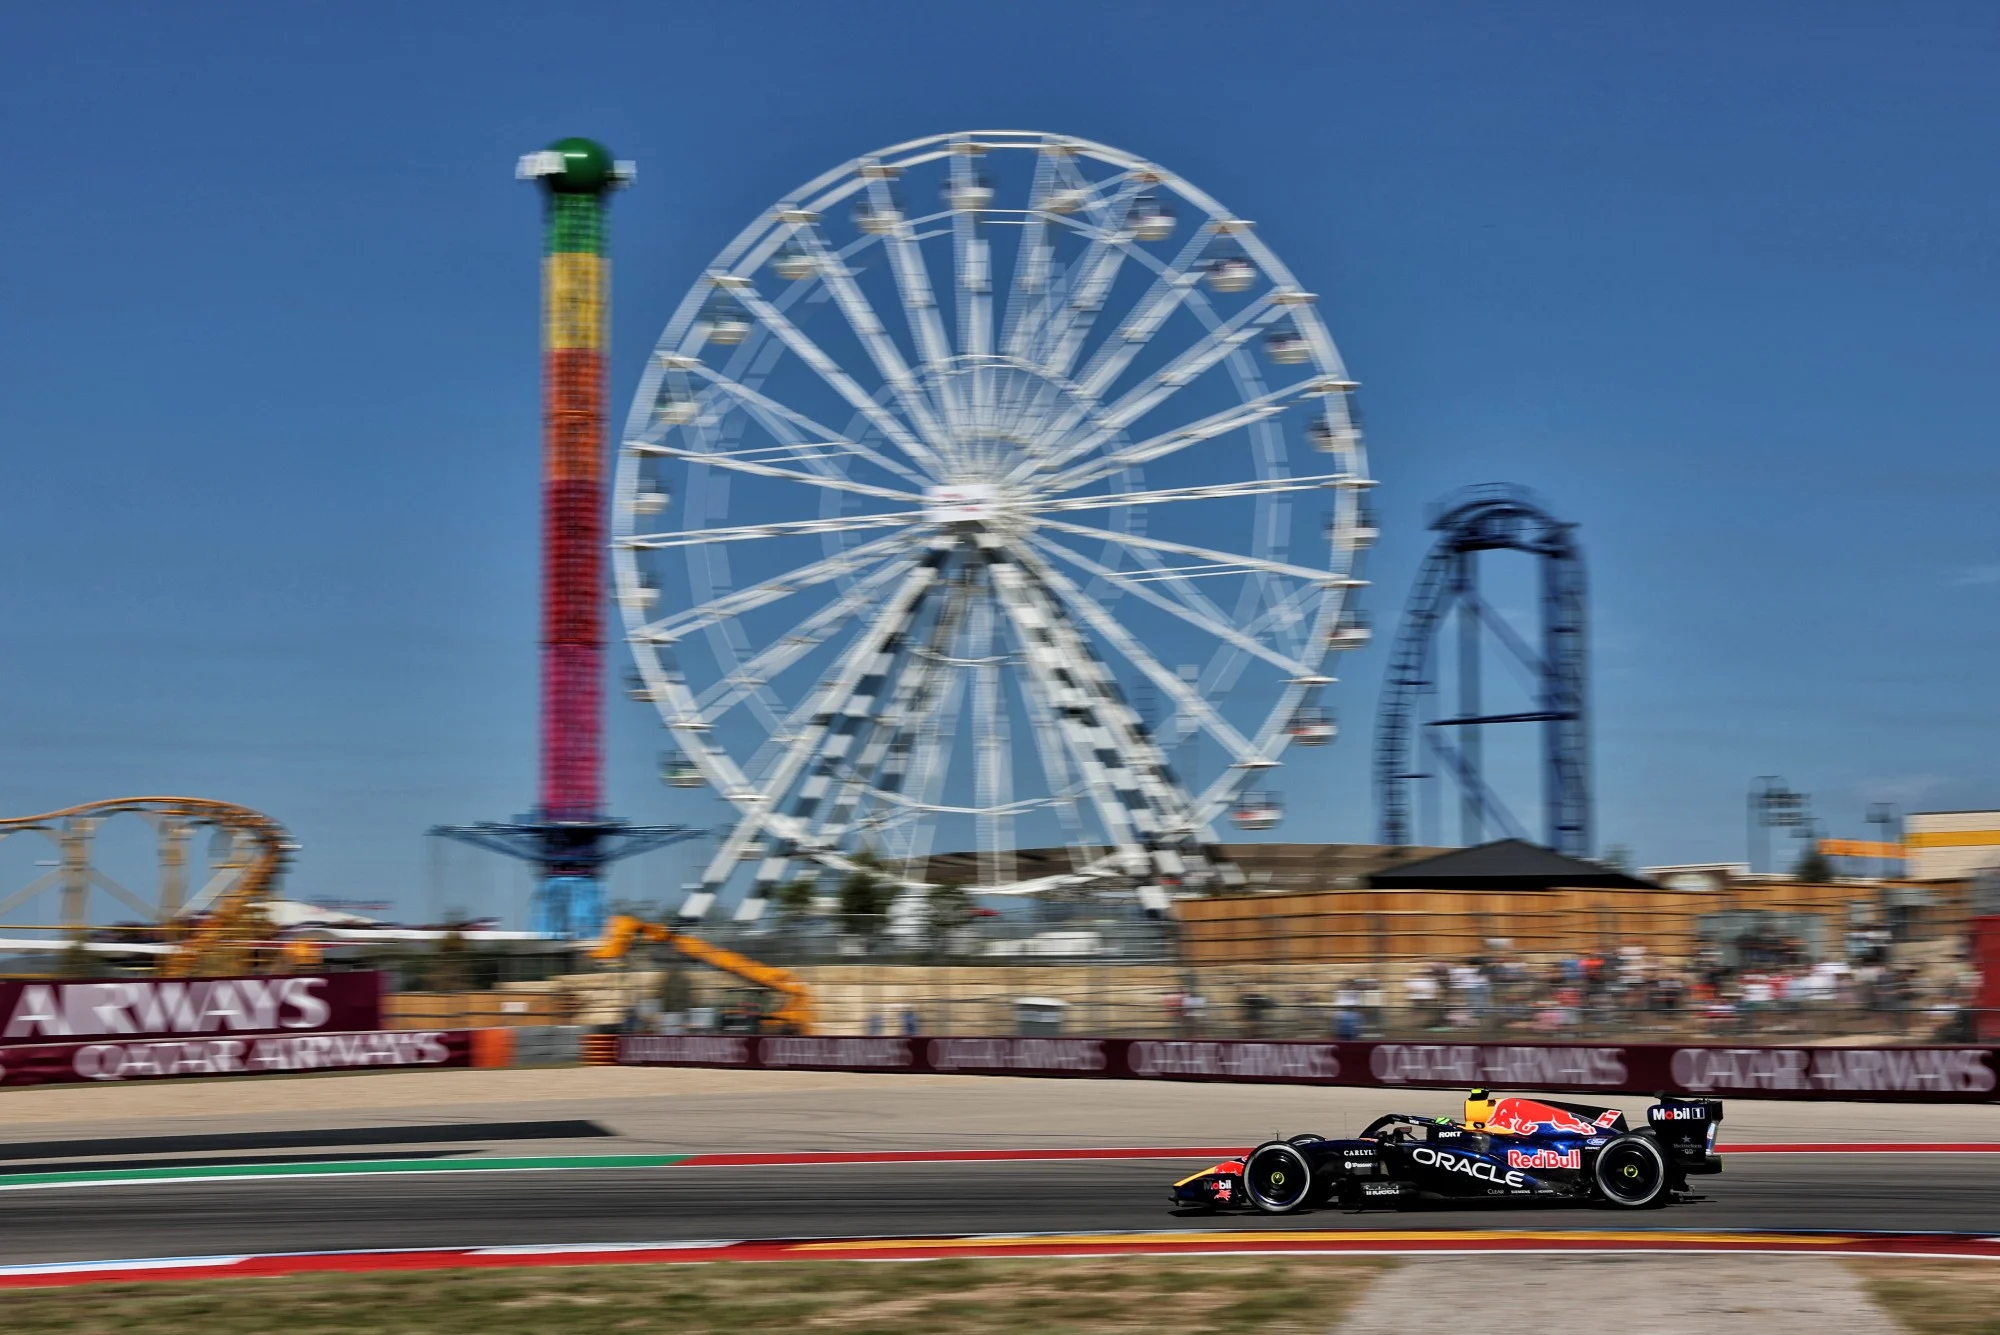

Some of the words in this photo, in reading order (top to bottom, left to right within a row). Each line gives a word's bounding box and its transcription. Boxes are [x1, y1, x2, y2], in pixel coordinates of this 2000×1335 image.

[2, 978, 331, 1037] AIRWAYS
[72, 1040, 246, 1080] QATAR
[247, 1032, 450, 1071] AIRWAYS
[1671, 1048, 1811, 1091] QATAR
[1811, 1050, 1997, 1092] AIRWAYS
[1653, 1107, 1690, 1120] Mobil
[1412, 1148, 1525, 1188] ORACLE
[1508, 1149, 1544, 1168] Red
[1545, 1149, 1581, 1169] Bull
